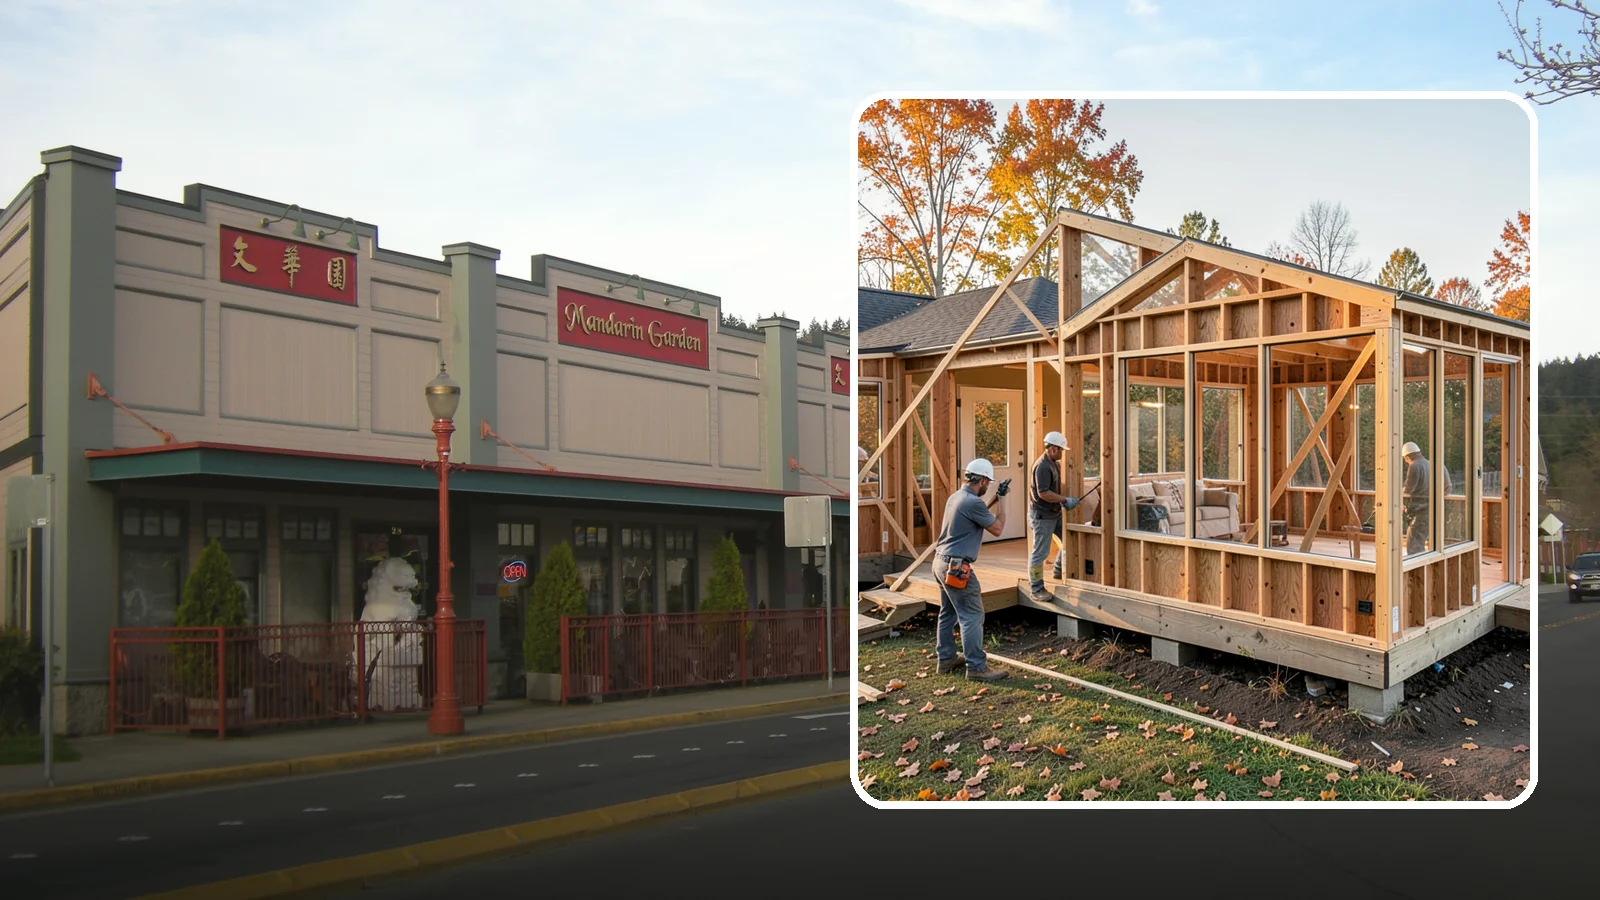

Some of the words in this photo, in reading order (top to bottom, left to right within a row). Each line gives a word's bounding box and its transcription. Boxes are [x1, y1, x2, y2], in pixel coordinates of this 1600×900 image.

[231, 235, 346, 291] 文華園
[565, 302, 644, 341] Mandarin
[648, 320, 701, 352] Garden
[503, 565, 527, 578] OPEN
